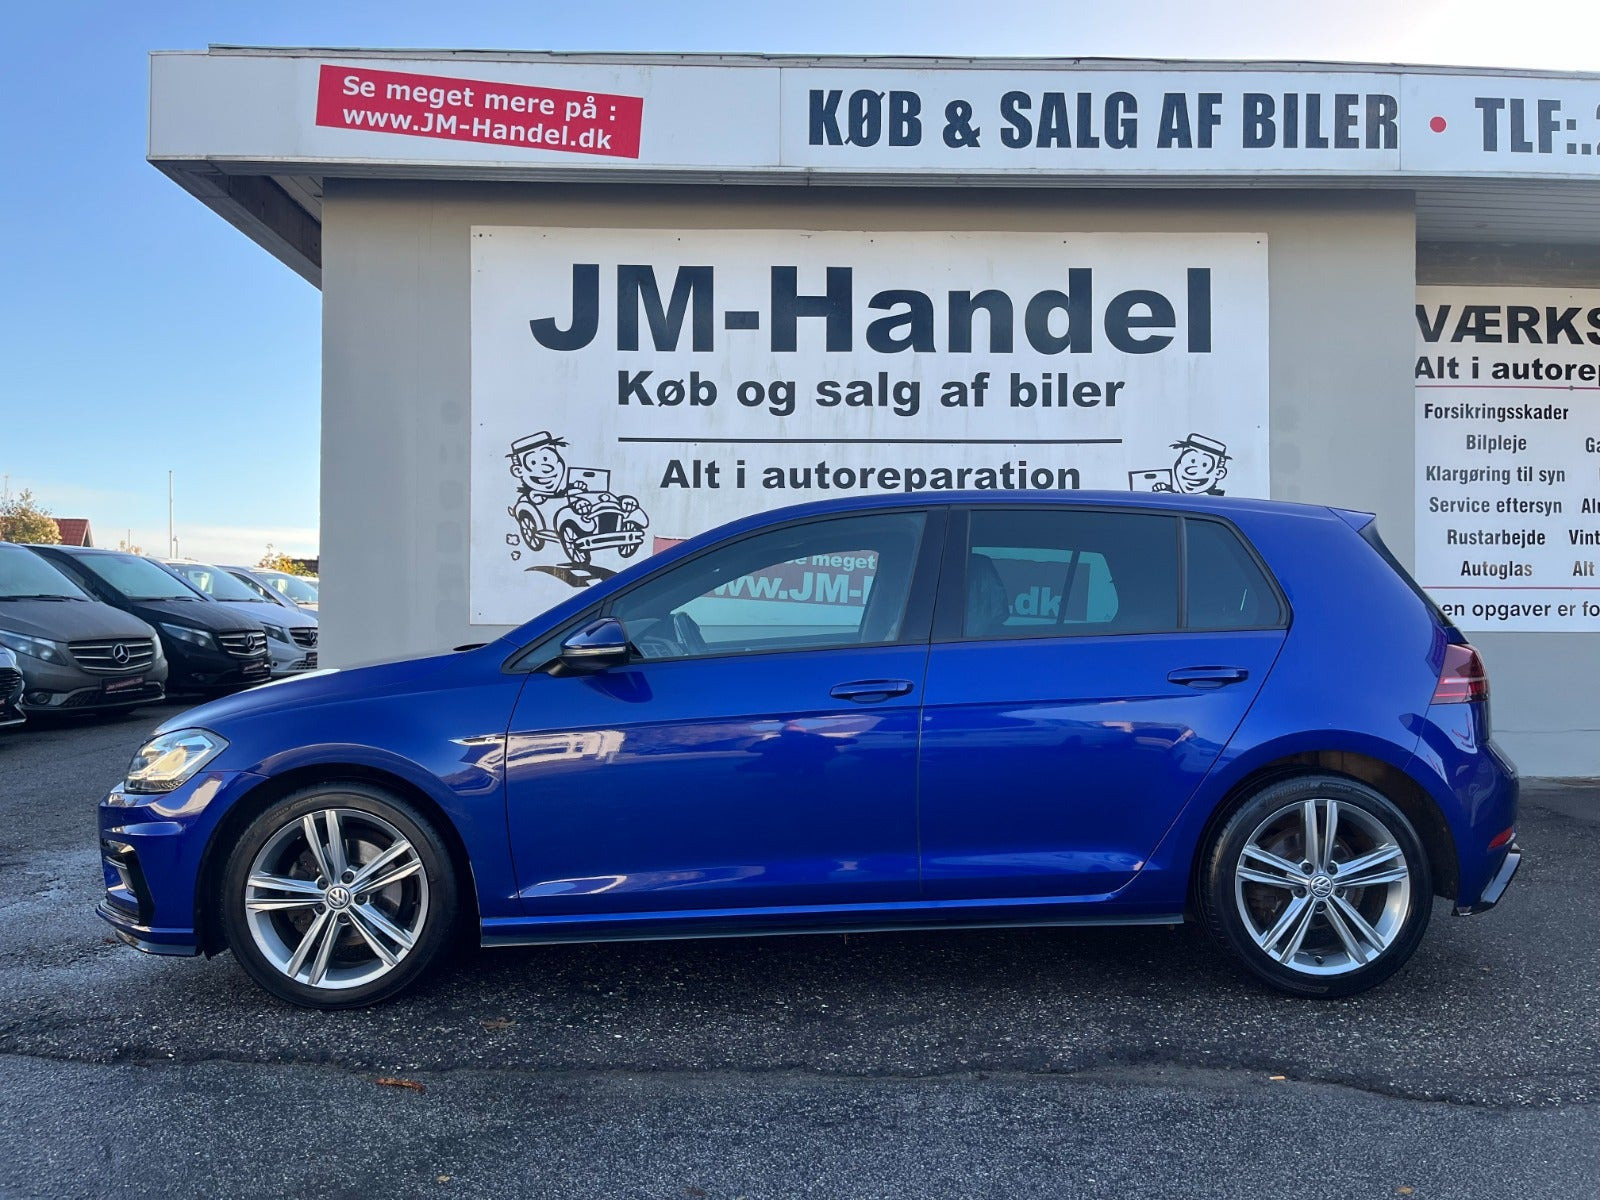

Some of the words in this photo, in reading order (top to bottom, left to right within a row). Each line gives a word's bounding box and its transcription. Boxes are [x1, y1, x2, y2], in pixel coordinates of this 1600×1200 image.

[342, 76, 375, 98] Se
[386, 83, 474, 109] meget
[484, 93, 555, 116] mere
[565, 95, 597, 122] på
[342, 108, 612, 150] www.JM-Handel.dk
[809, 89, 922, 147] KØB
[943, 100, 981, 148] &
[1000, 91, 1137, 149] SALG
[1157, 93, 1223, 148] AF
[1242, 93, 1398, 149] BILER
[1475, 97, 1600, 157] TLF:.
[529, 263, 1212, 355] JM-Handel
[1415, 356, 1459, 379] Alt
[1472, 356, 1479, 379] i
[1492, 358, 1600, 387] autore
[618, 370, 718, 408] Køb
[737, 380, 796, 417] og
[815, 371, 921, 417] salg
[940, 372, 990, 407] af
[1010, 373, 1125, 408] biler
[1424, 403, 1569, 422] Forsikringsskader
[1466, 434, 1527, 454] Bilpleje
[660, 459, 720, 489] Alt
[737, 460, 745, 489] i
[762, 460, 1081, 493] autoreparation
[1426, 465, 1511, 485] Klargøring
[1517, 466, 1533, 482] til
[1539, 470, 1566, 485] syn
[1429, 497, 1490, 513] Service
[1496, 498, 1562, 516] eftersyn
[1447, 529, 1546, 549] Rustarbejde
[812, 555, 875, 572] meget
[1460, 560, 1533, 580] Autoglas
[1572, 560, 1595, 577] Alt
[1438, 604, 1465, 617] en
[1472, 604, 1551, 621] opgaver
[1557, 604, 1576, 617] er
